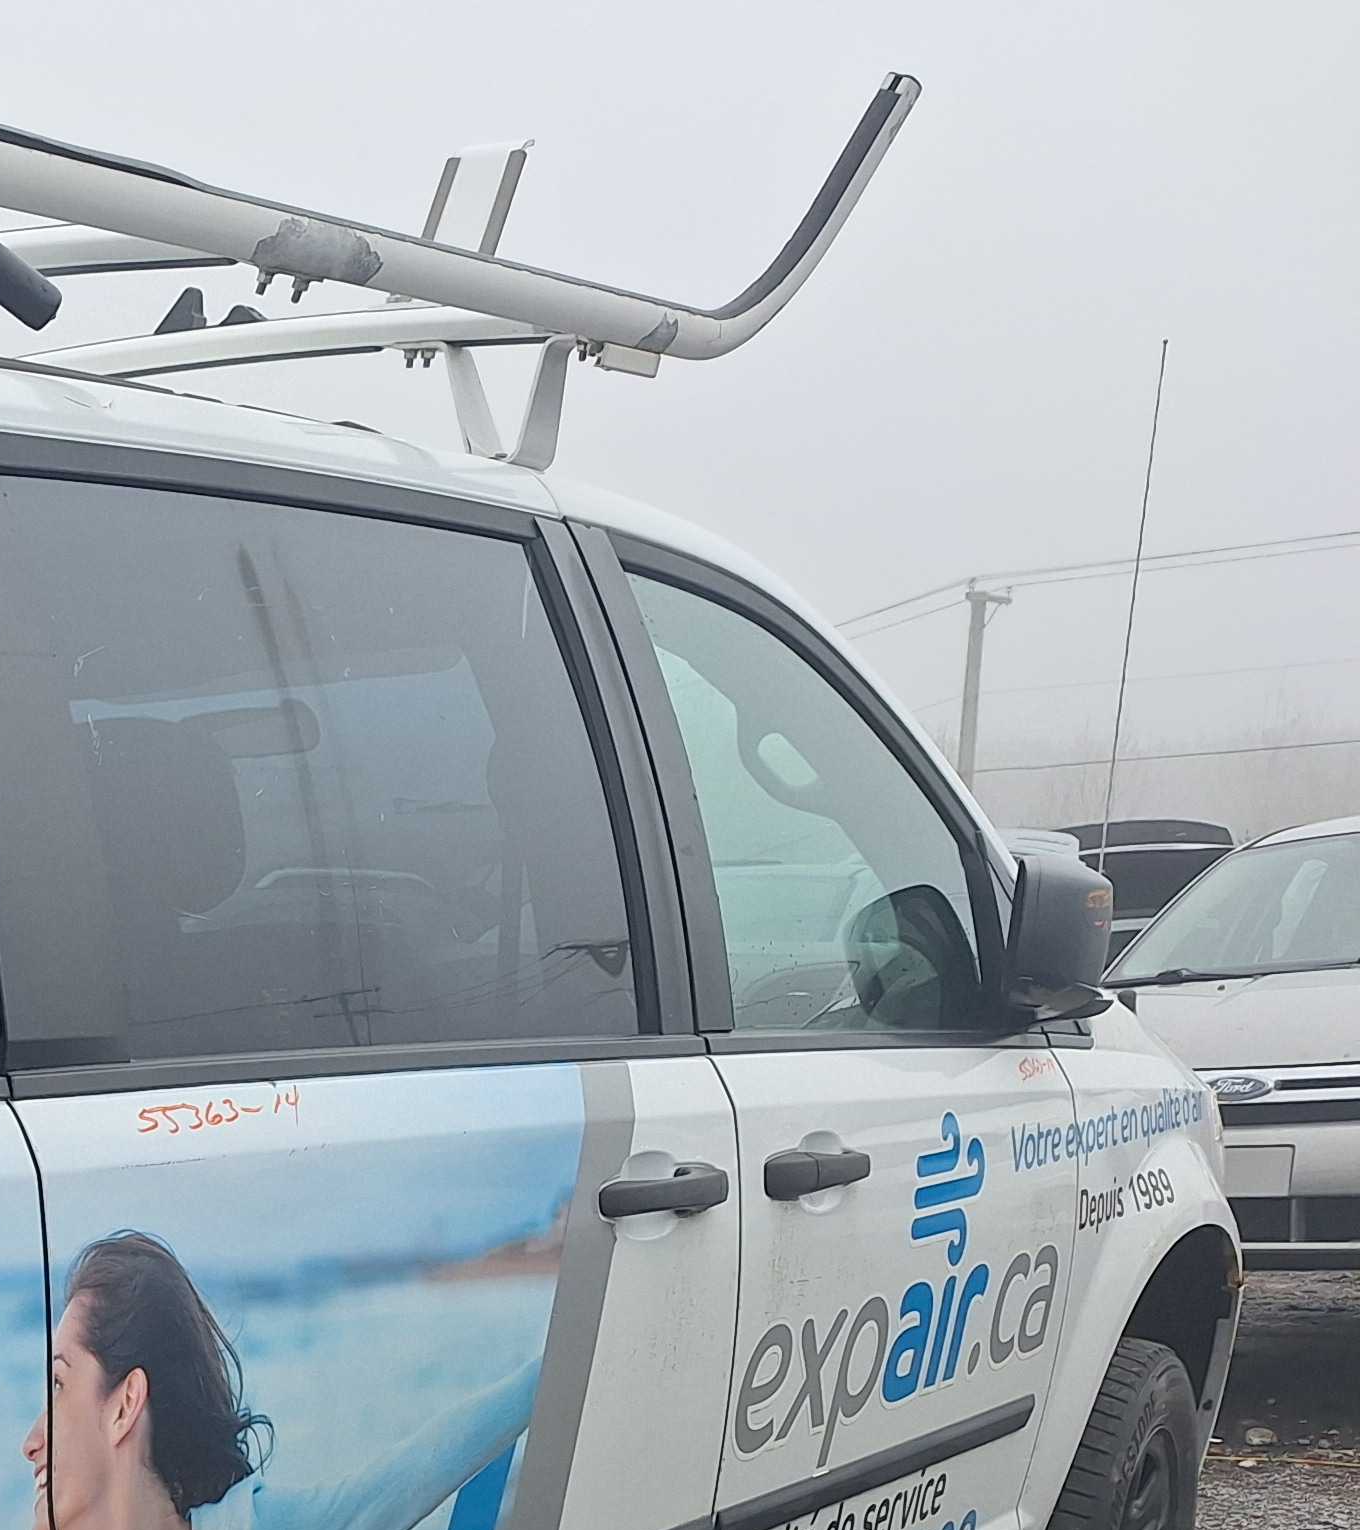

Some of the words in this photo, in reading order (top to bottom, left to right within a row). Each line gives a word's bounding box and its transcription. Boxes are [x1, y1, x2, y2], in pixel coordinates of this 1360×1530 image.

[1213, 1077, 1256, 1096] Ford
[1011, 1121, 1061, 1173] Votre
[1065, 1105, 1119, 1167] expert
[1120, 1108, 1138, 1145] en
[1079, 1177, 1124, 1234] Depuis
[1128, 1167, 1175, 1213] 1989
[734, 1244, 1059, 1470] expair.ca
